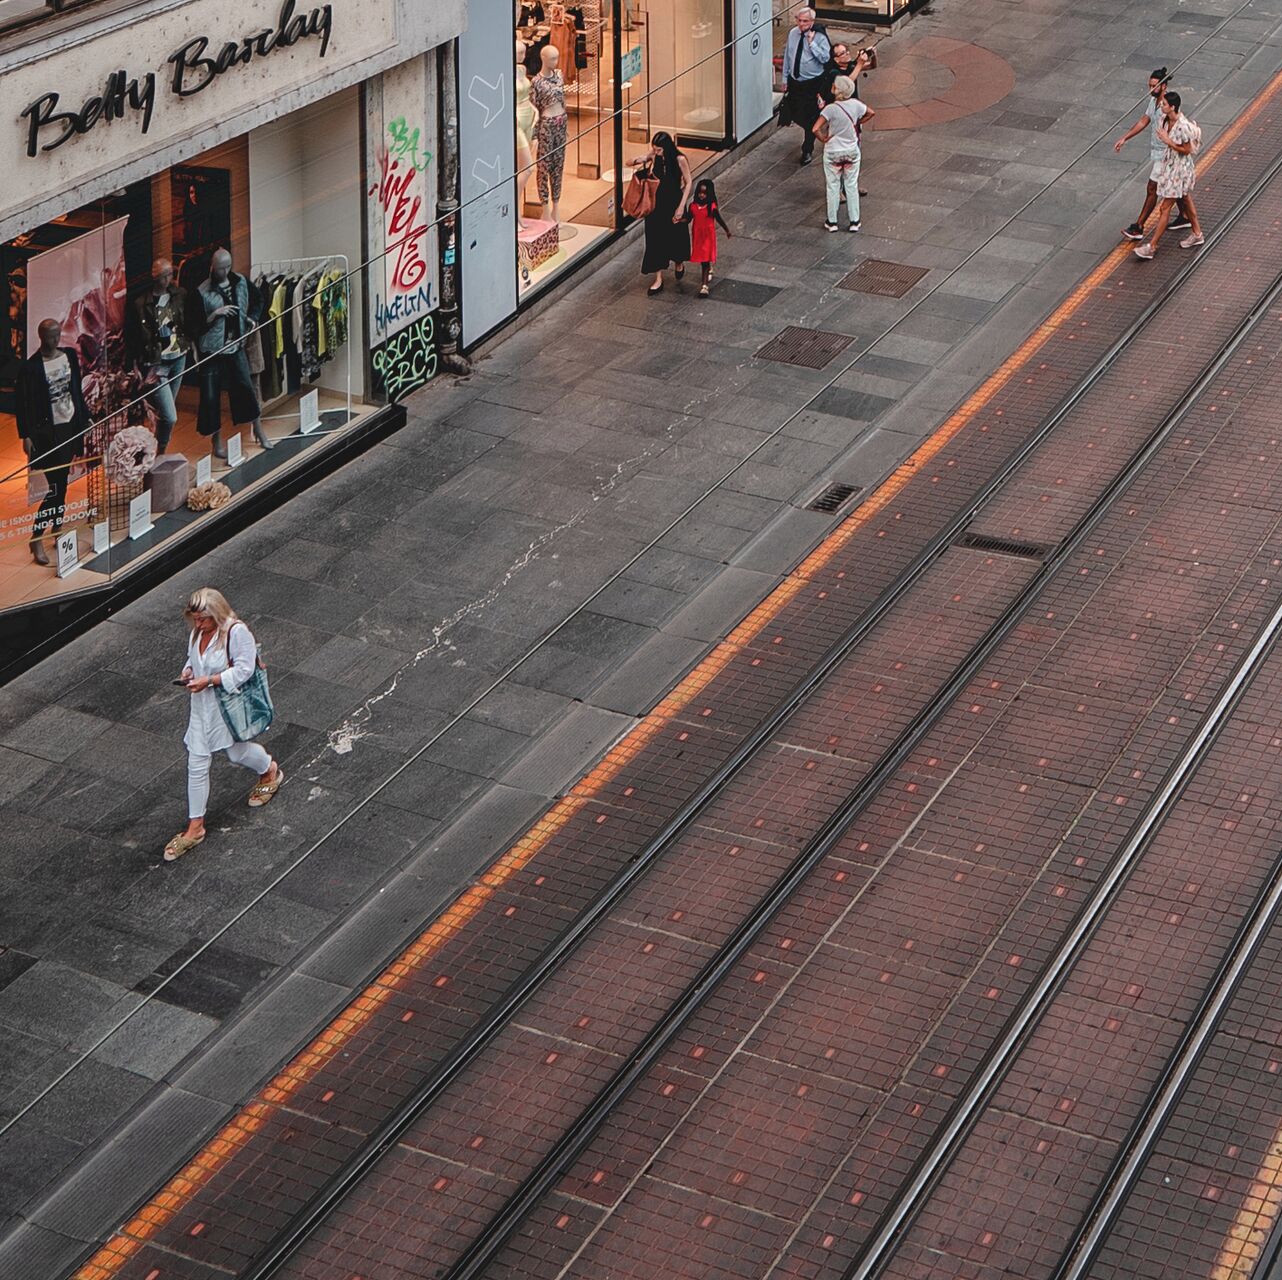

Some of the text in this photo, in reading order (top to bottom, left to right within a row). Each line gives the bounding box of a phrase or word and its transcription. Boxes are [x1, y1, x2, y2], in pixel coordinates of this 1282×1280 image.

[20, 69, 156, 158] Betty
[10, 507, 56, 526] ISKORISTI
[58, 498, 90, 514] SVOJE
[17, 519, 54, 536] TRENDS
[56, 507, 98, 525] BODOVE
